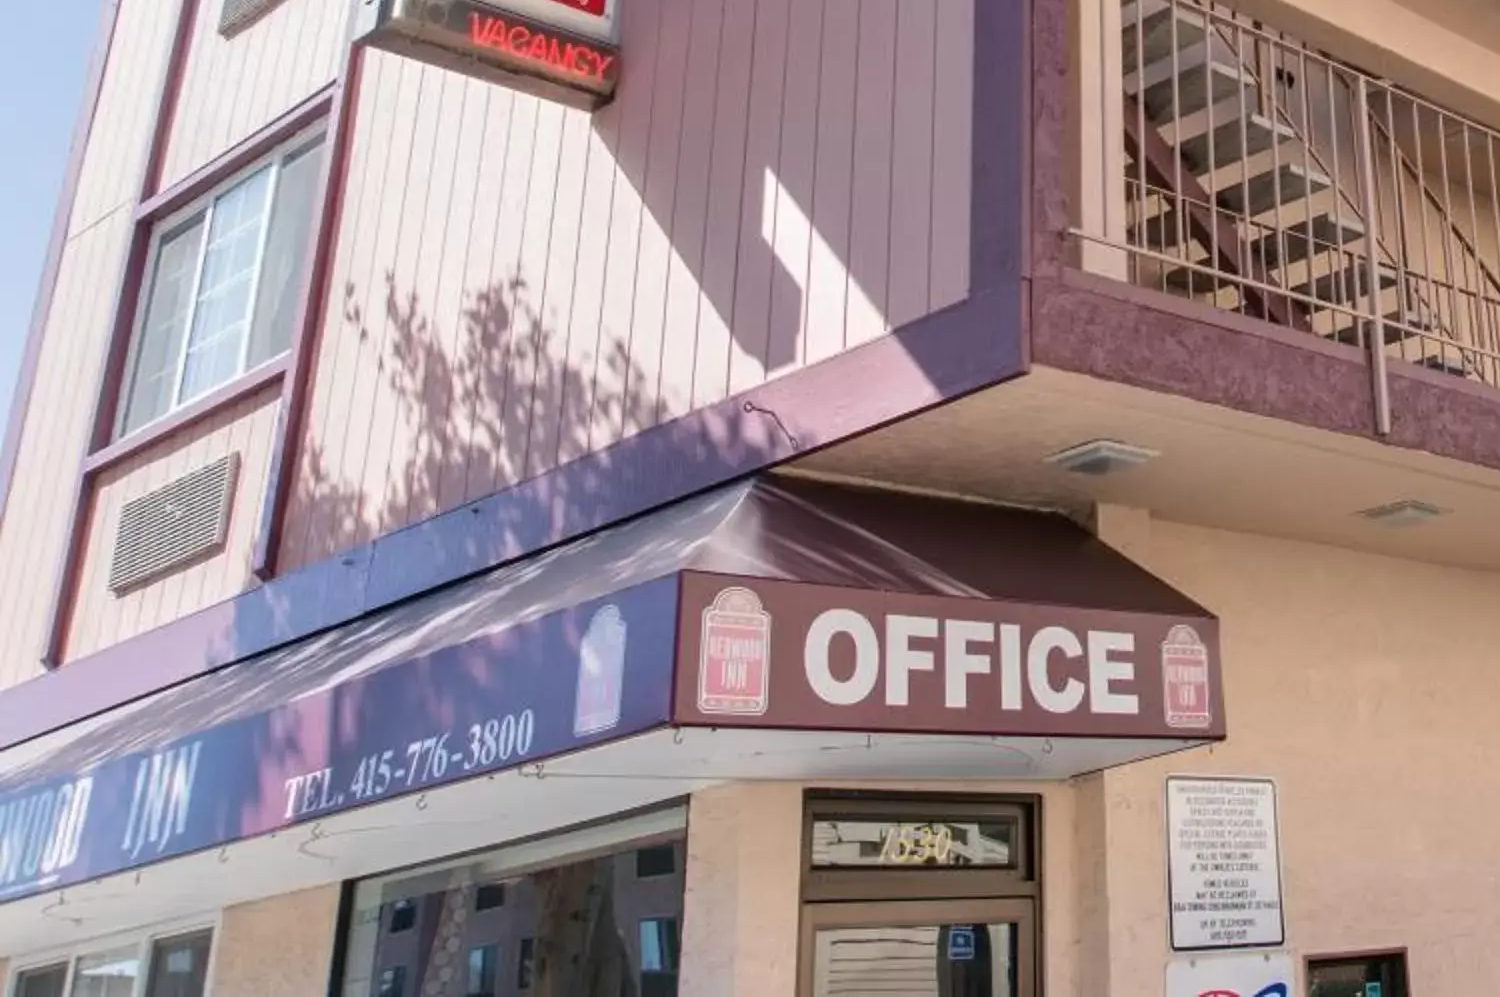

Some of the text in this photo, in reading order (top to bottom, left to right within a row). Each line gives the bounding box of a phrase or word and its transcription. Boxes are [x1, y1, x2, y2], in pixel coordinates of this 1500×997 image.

[470, 11, 615, 84] VACANCY
[804, 608, 1139, 714] OFFICE
[121, 740, 203, 860] INN
[284, 768, 345, 820] TEL.
[351, 709, 535, 800] 415-776-3800
